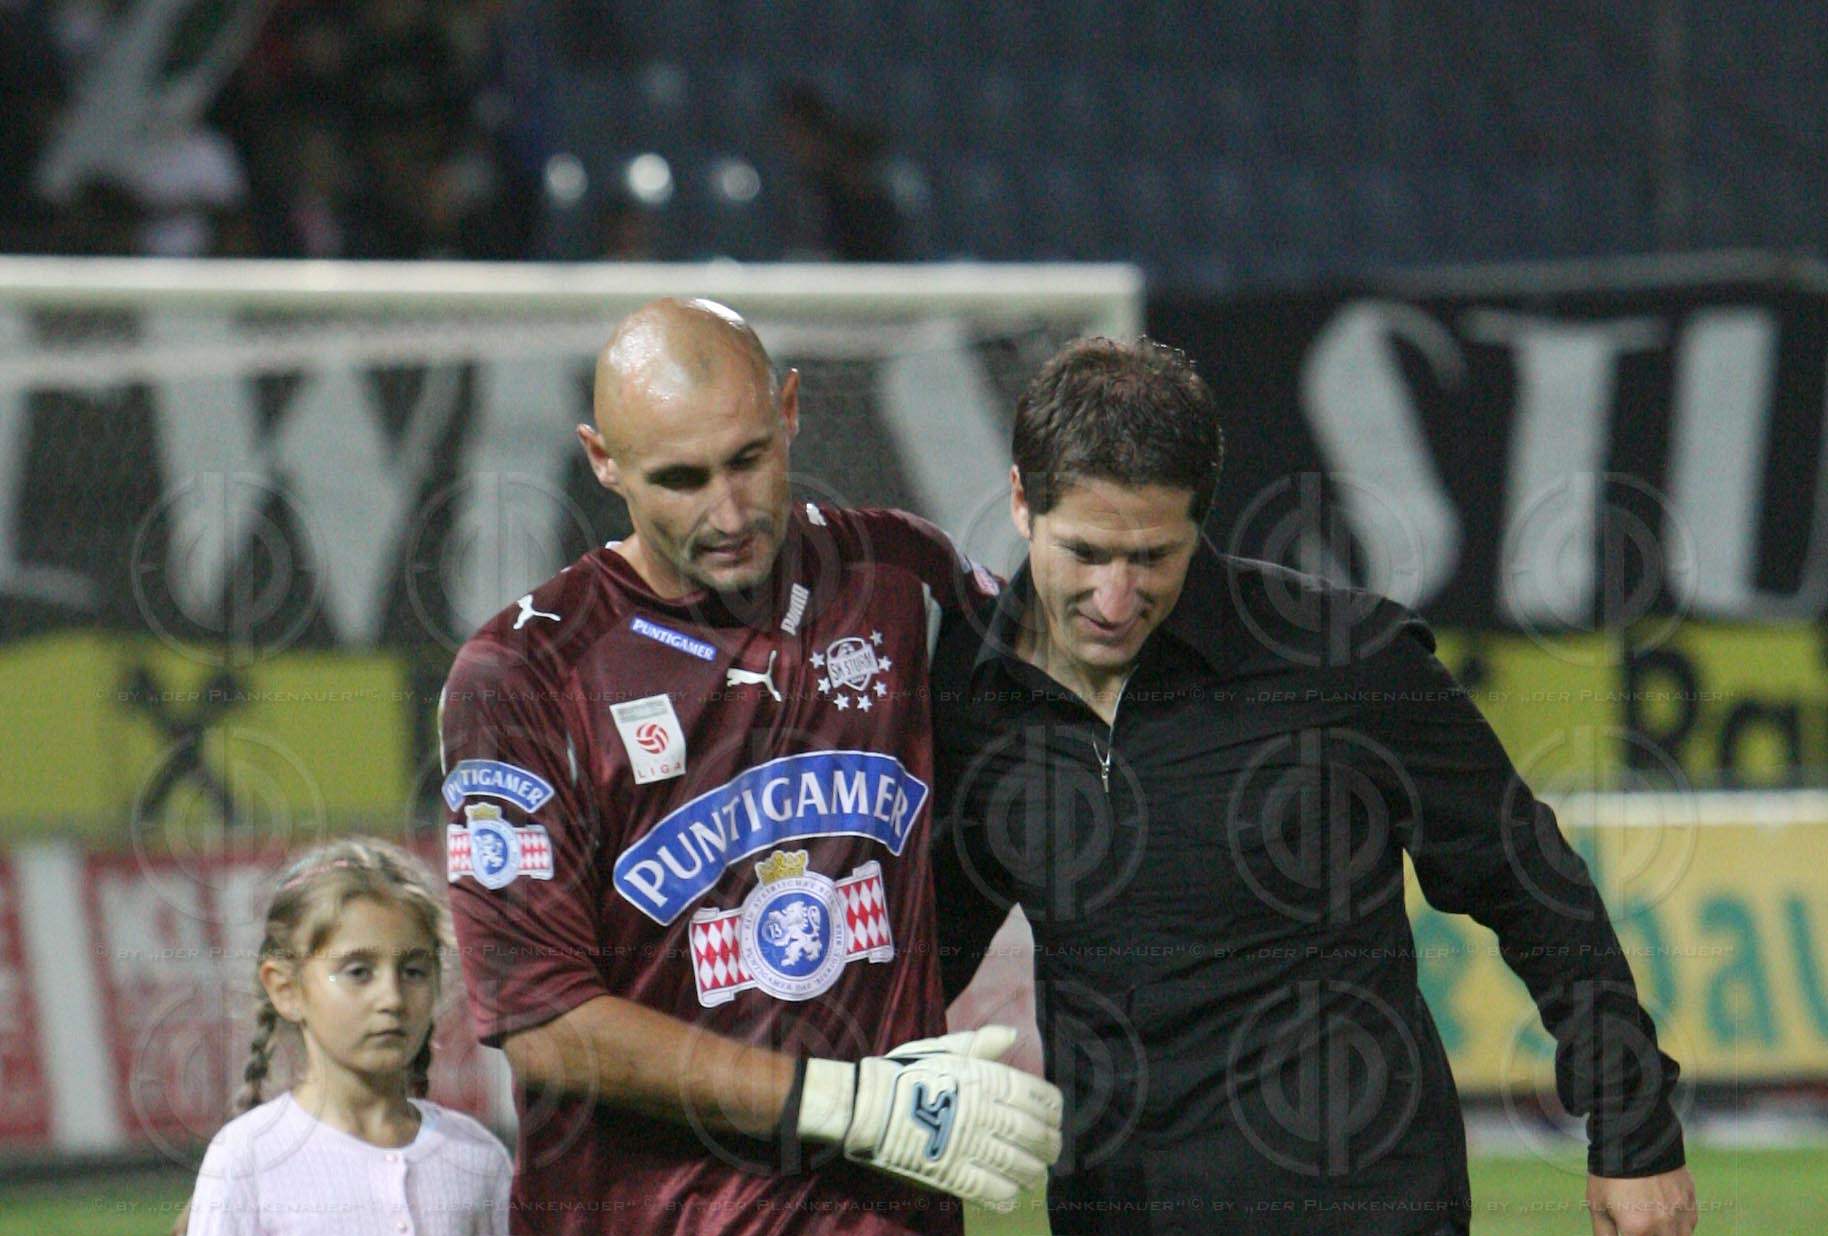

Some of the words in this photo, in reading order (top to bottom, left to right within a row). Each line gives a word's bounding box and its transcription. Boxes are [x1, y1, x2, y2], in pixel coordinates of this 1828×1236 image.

[632, 618, 714, 661] PUNTIGAMER
[637, 760, 682, 778] LIGA
[623, 769, 909, 908] PUNTIGAMER
